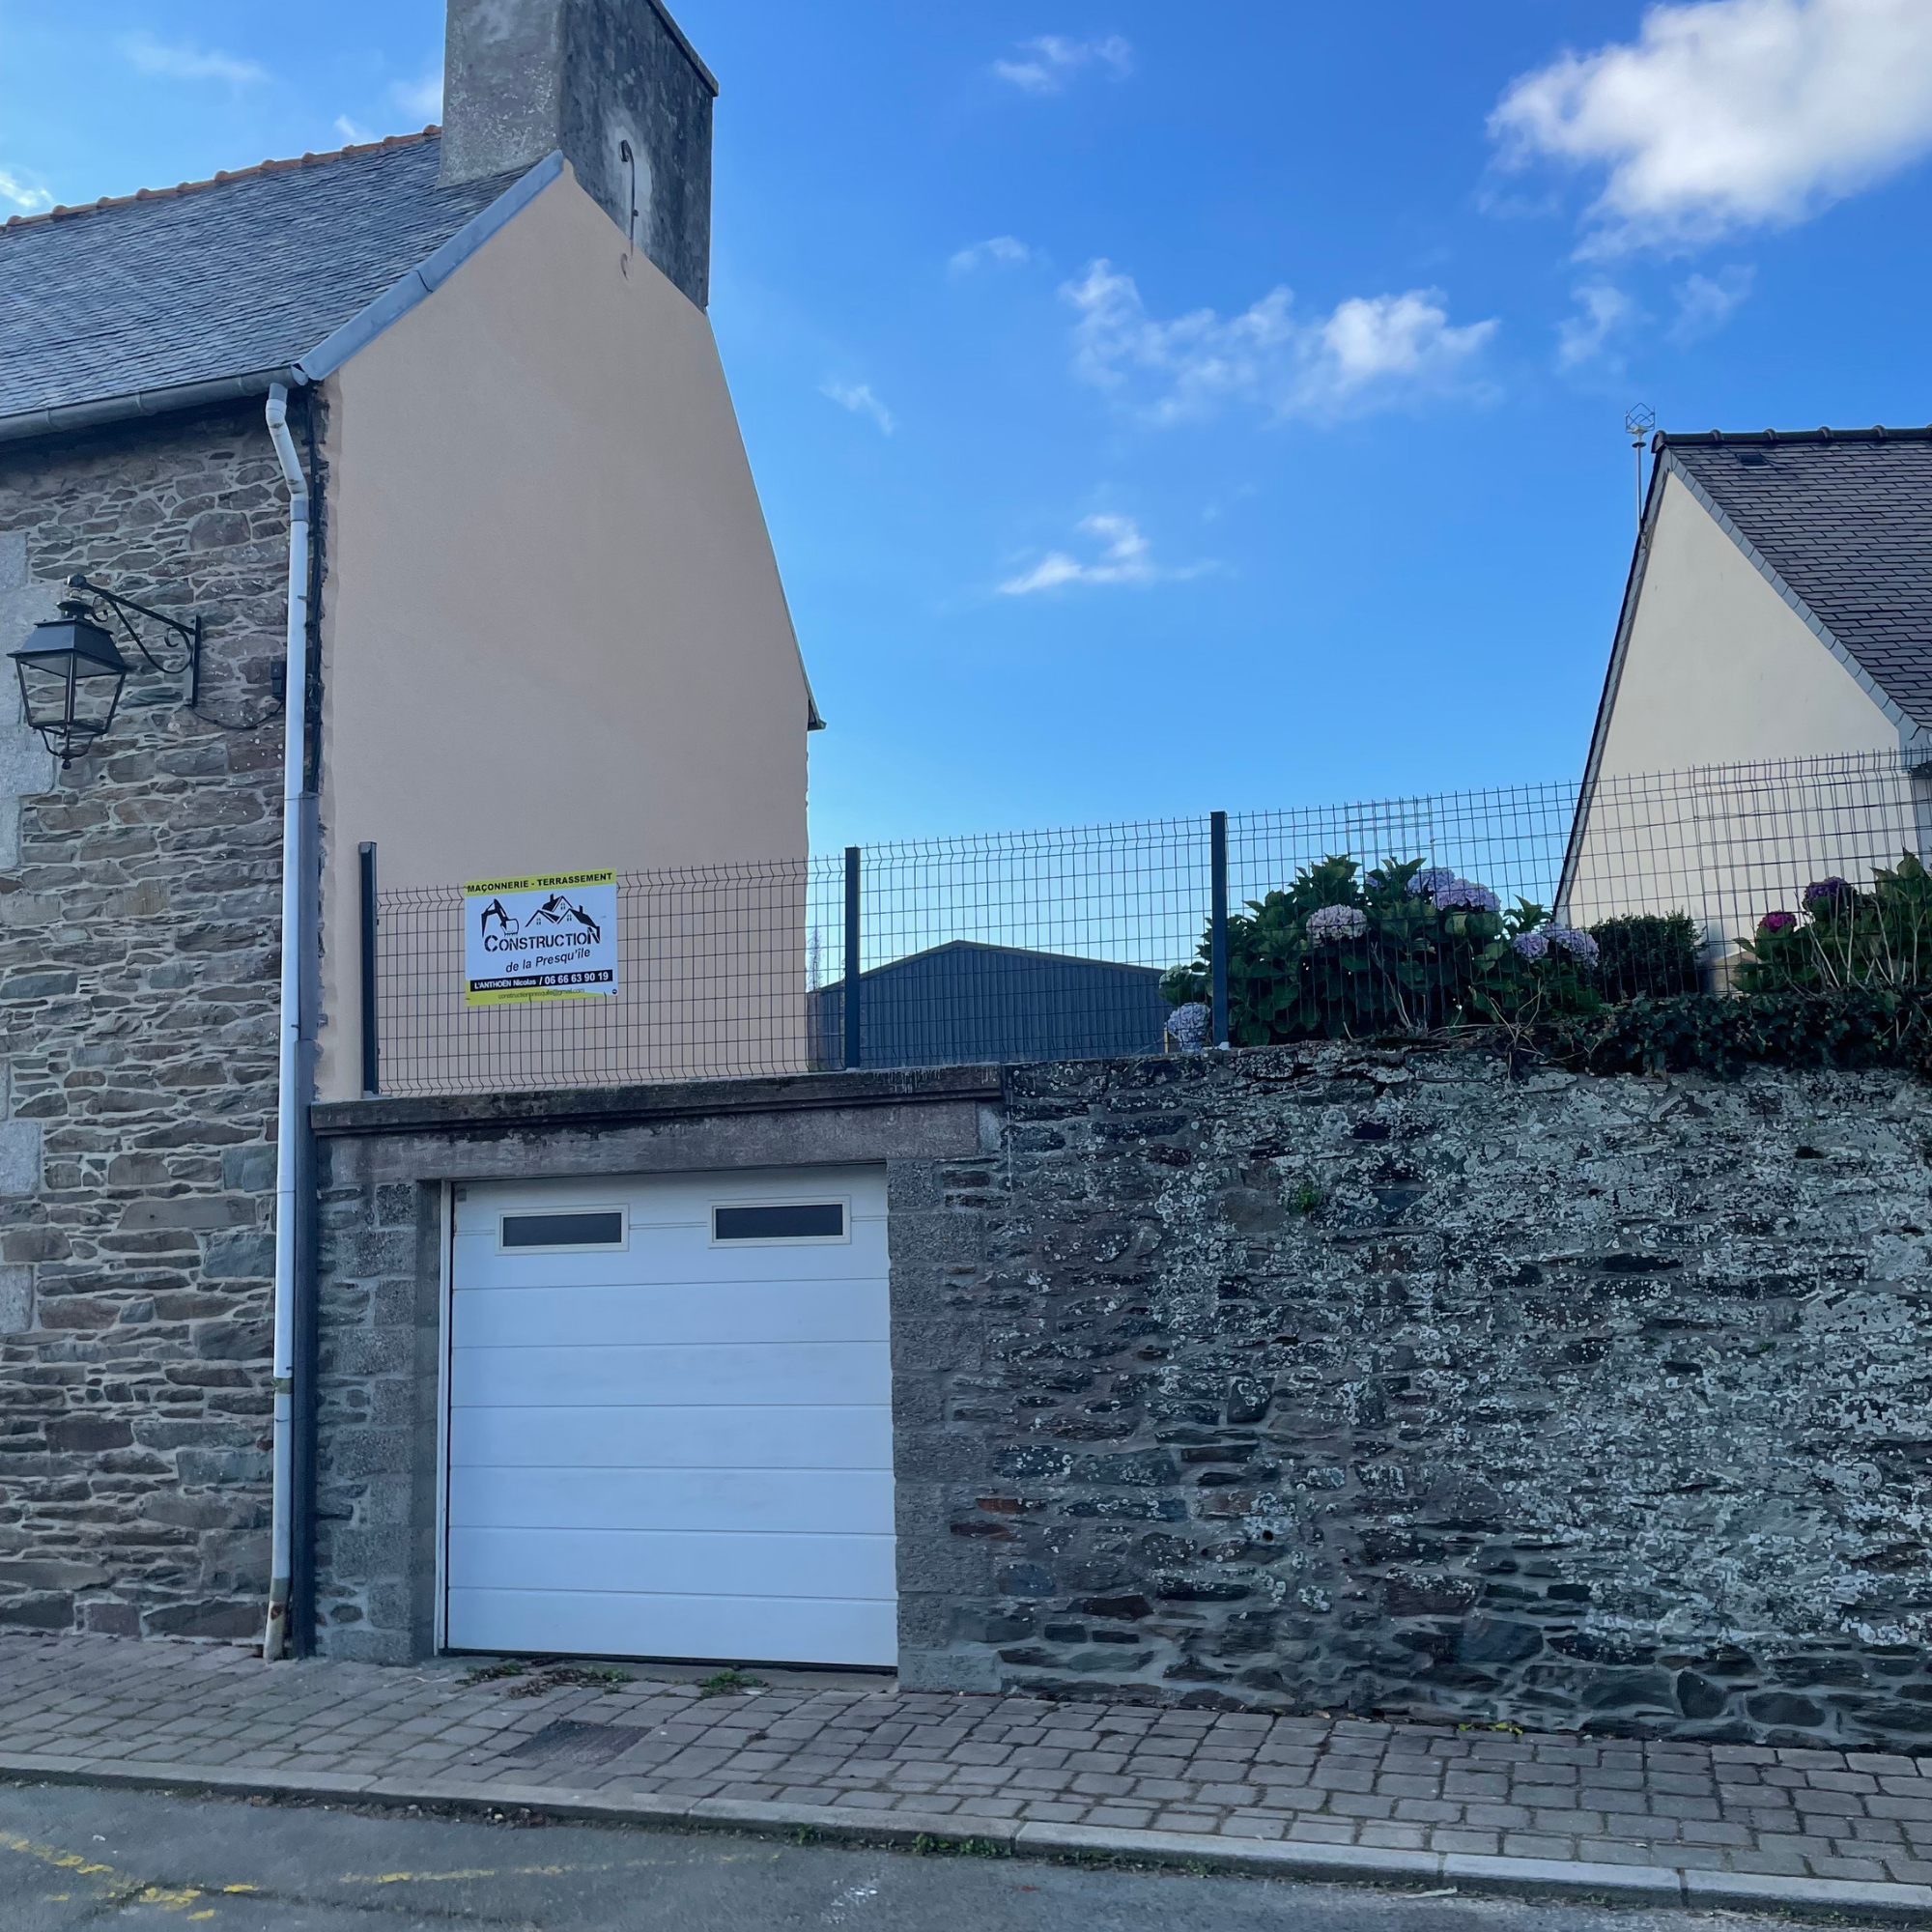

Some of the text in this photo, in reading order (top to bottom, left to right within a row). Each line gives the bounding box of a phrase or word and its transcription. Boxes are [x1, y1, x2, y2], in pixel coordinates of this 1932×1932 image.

[467, 880, 529, 893] MAÇONNERIE
[537, 872, 612, 887] TERRASSEMENT
[484, 926, 601, 952] CONSTRUCTION
[505, 948, 590, 973] de la Presqu'île
[544, 976, 555, 985] 06
[557, 975, 569, 983] 66
[571, 973, 582, 982] 63
[583, 972, 595, 982] 90
[597, 971, 609, 980] 19
